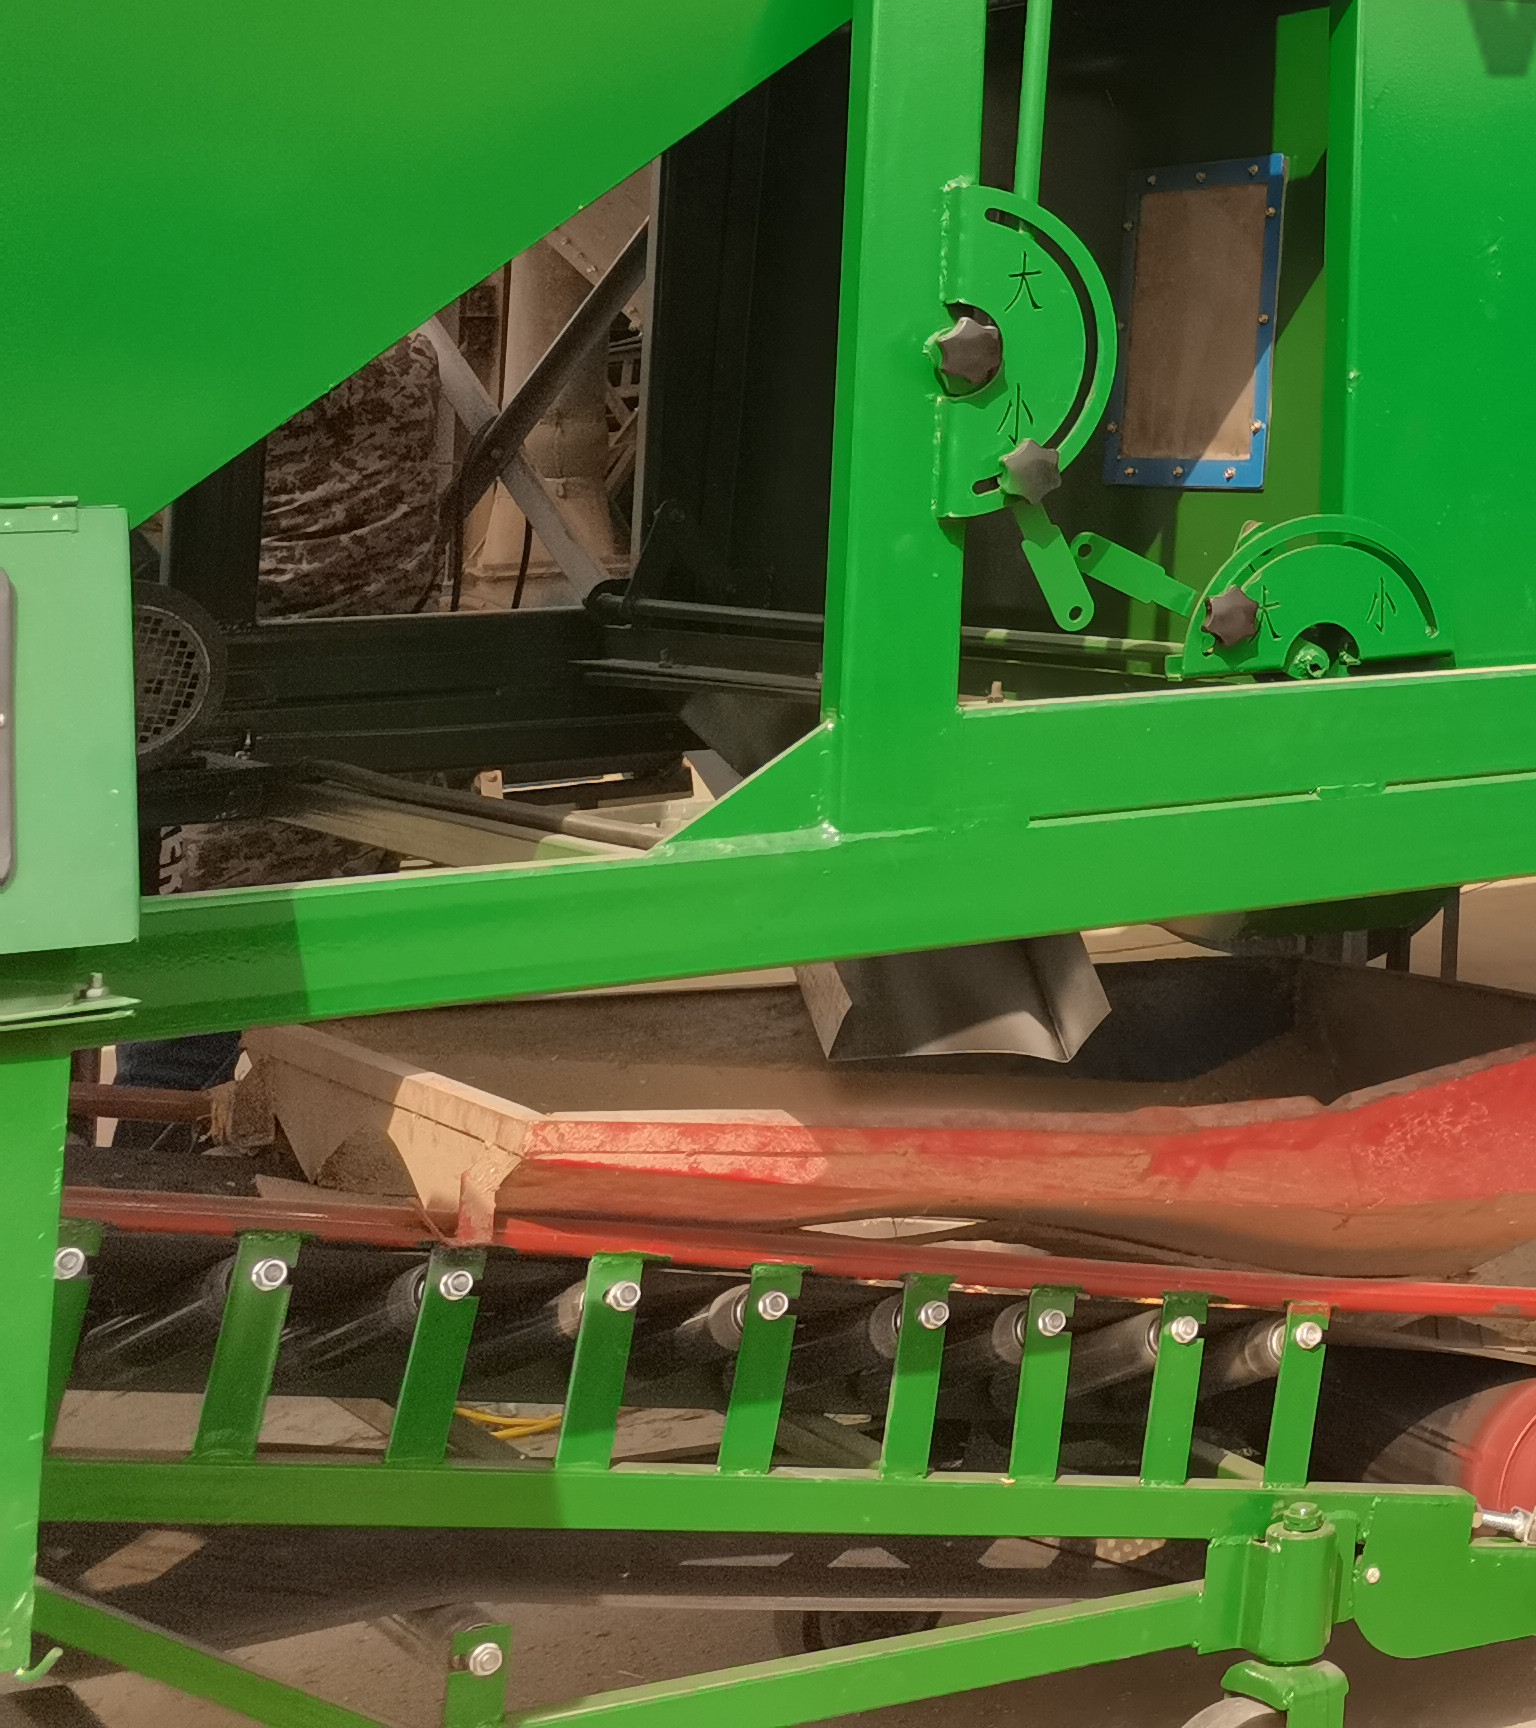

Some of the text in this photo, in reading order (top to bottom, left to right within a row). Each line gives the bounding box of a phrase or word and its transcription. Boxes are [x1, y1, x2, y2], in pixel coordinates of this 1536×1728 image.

[1004, 251, 1044, 313] 大
[997, 382, 1034, 448] 小
[1366, 576, 1397, 634] 小
